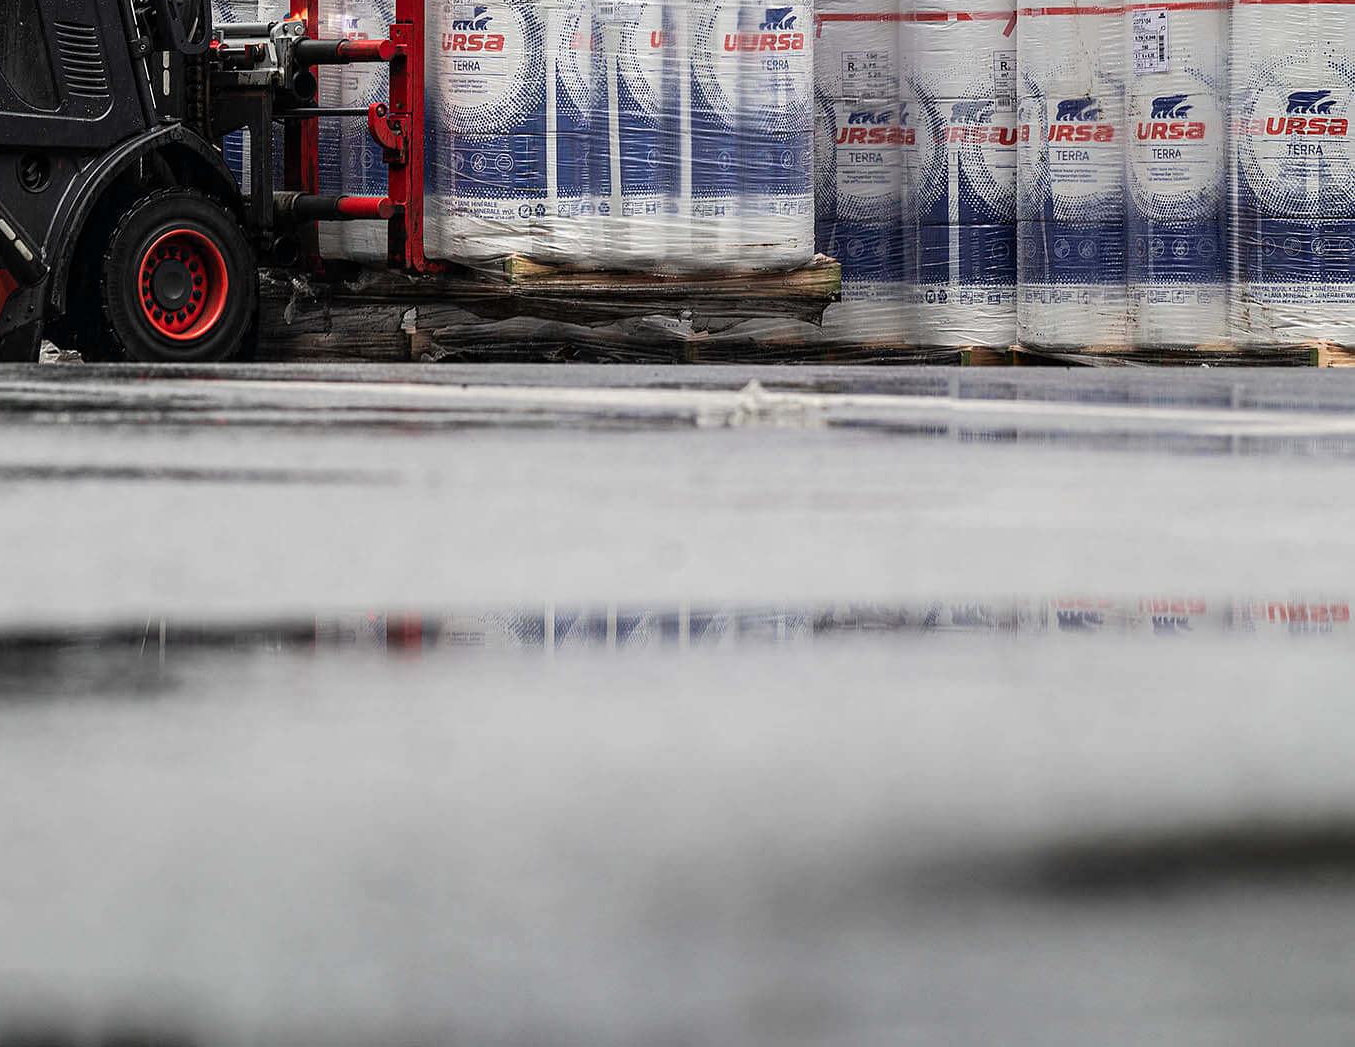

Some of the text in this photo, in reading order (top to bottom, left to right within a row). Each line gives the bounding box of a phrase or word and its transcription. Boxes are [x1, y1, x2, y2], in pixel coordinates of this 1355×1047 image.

[442, 32, 505, 52] URSA
[453, 60, 481, 72] TERRA
[762, 59, 790, 71] TERRA
[848, 62, 855, 71] R
[1137, 121, 1206, 141] URSA
[1266, 117, 1349, 136] URSA
[1043, 124, 1115, 143] URSA
[1152, 148, 1182, 160] TERRA
[1286, 143, 1324, 156] TERRA
[849, 152, 884, 164] TERRA
[1057, 150, 1091, 162] TERRA
